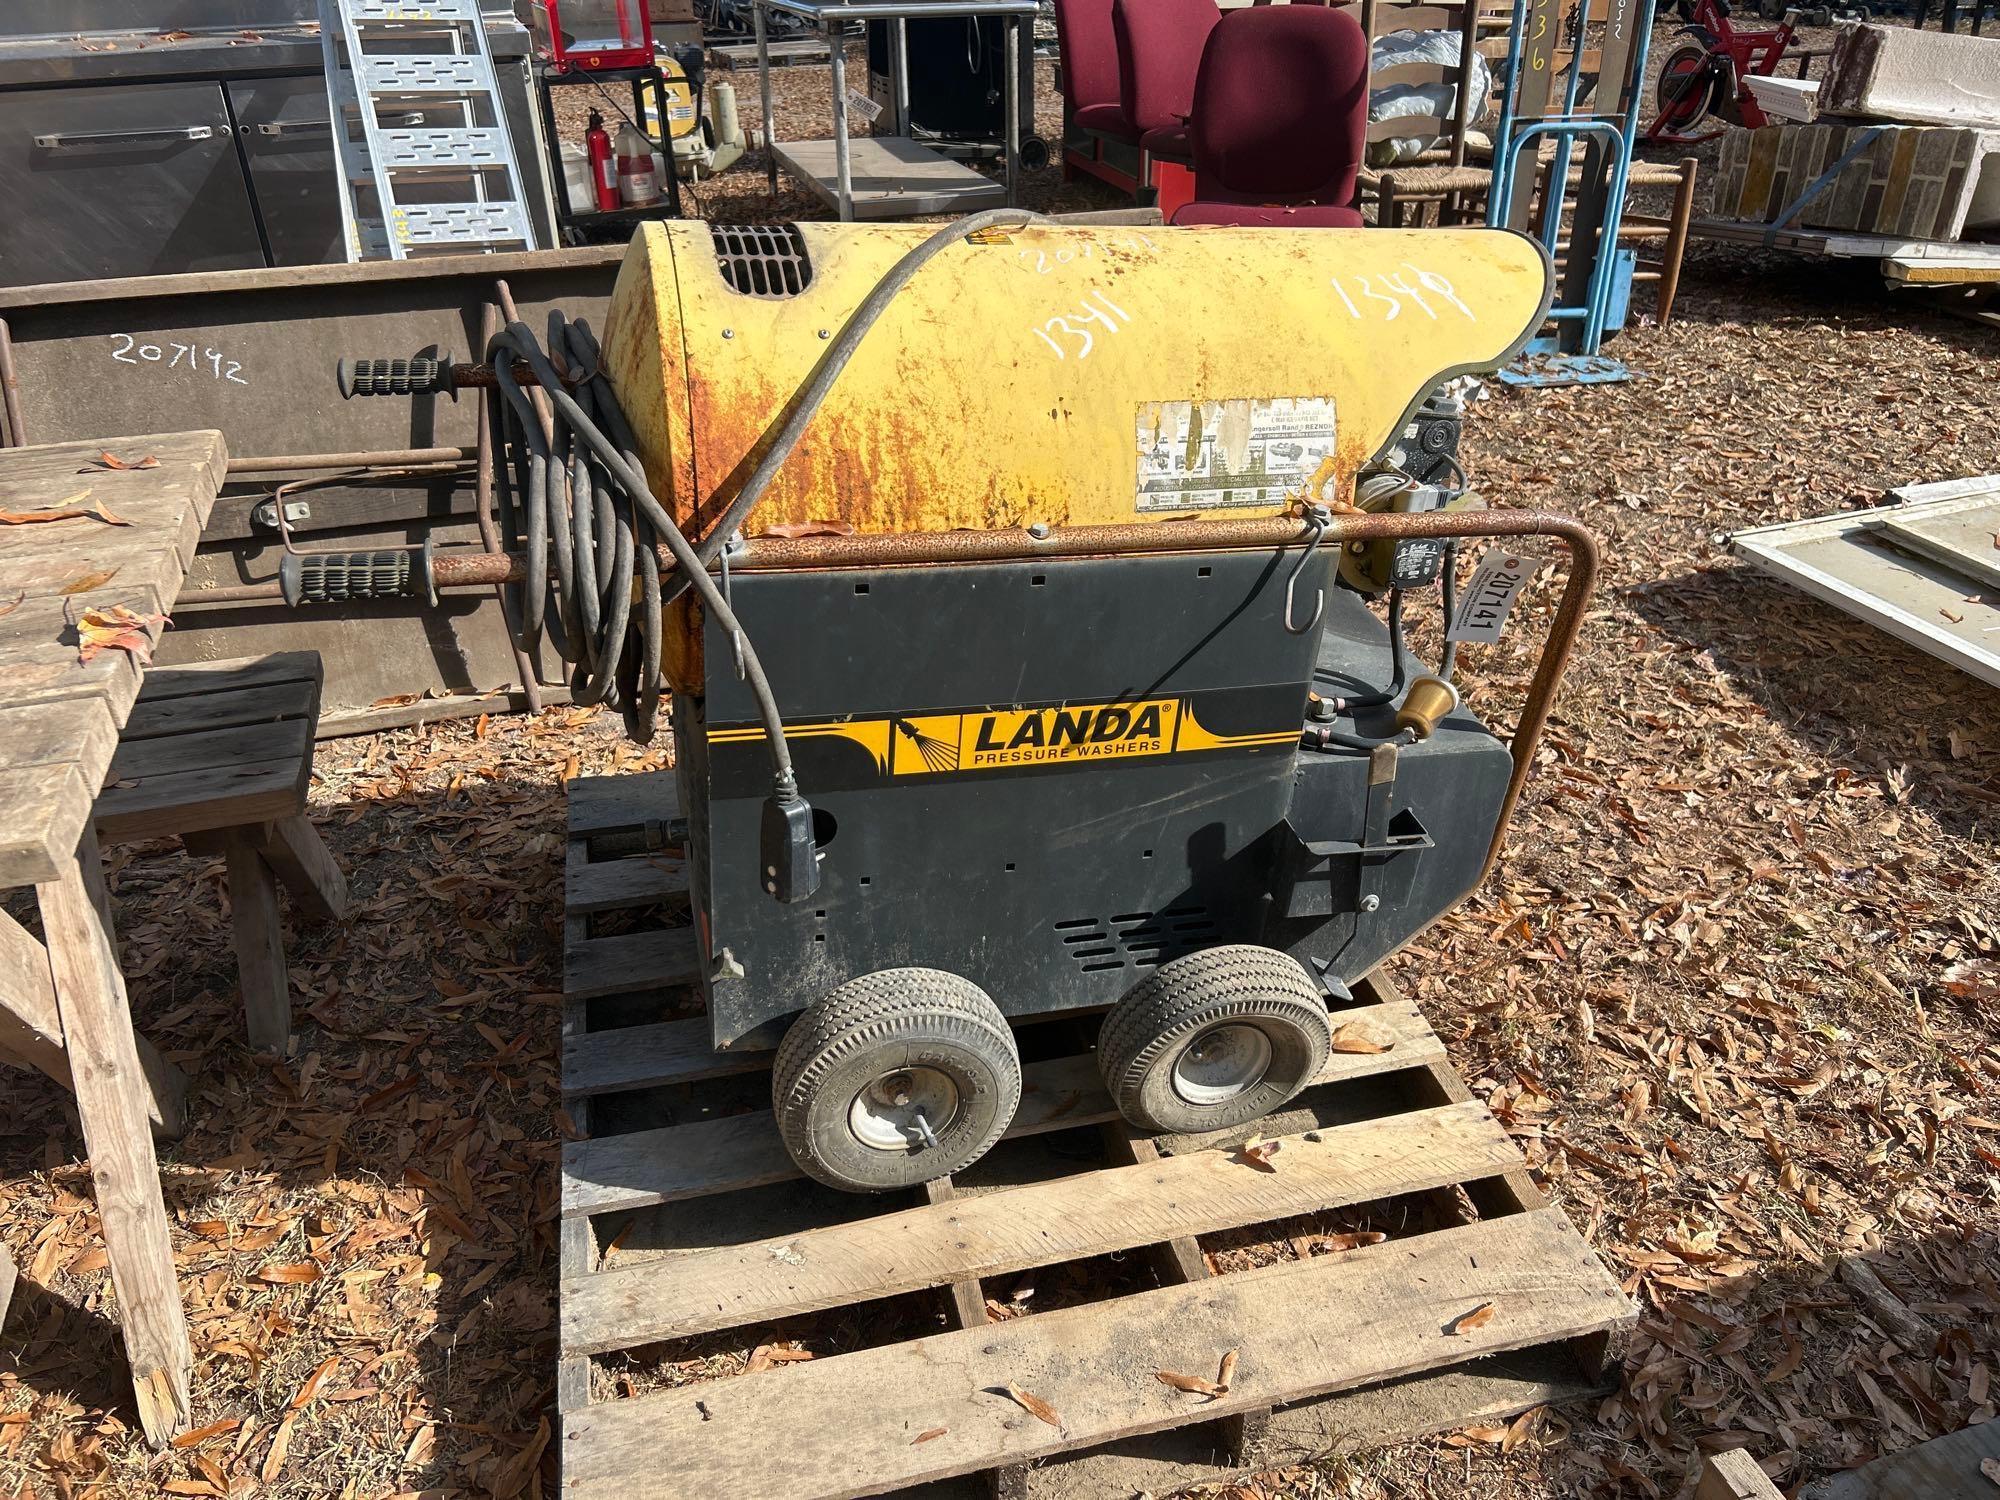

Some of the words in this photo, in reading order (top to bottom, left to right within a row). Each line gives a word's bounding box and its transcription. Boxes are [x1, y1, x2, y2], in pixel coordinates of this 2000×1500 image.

[1032, 290, 1131, 360] 1341
[110, 332, 249, 385] 207142
[1469, 571, 1521, 628] 207141
[974, 748, 1070, 765] PRESSURE
[1077, 740, 1161, 757] WASHERS
